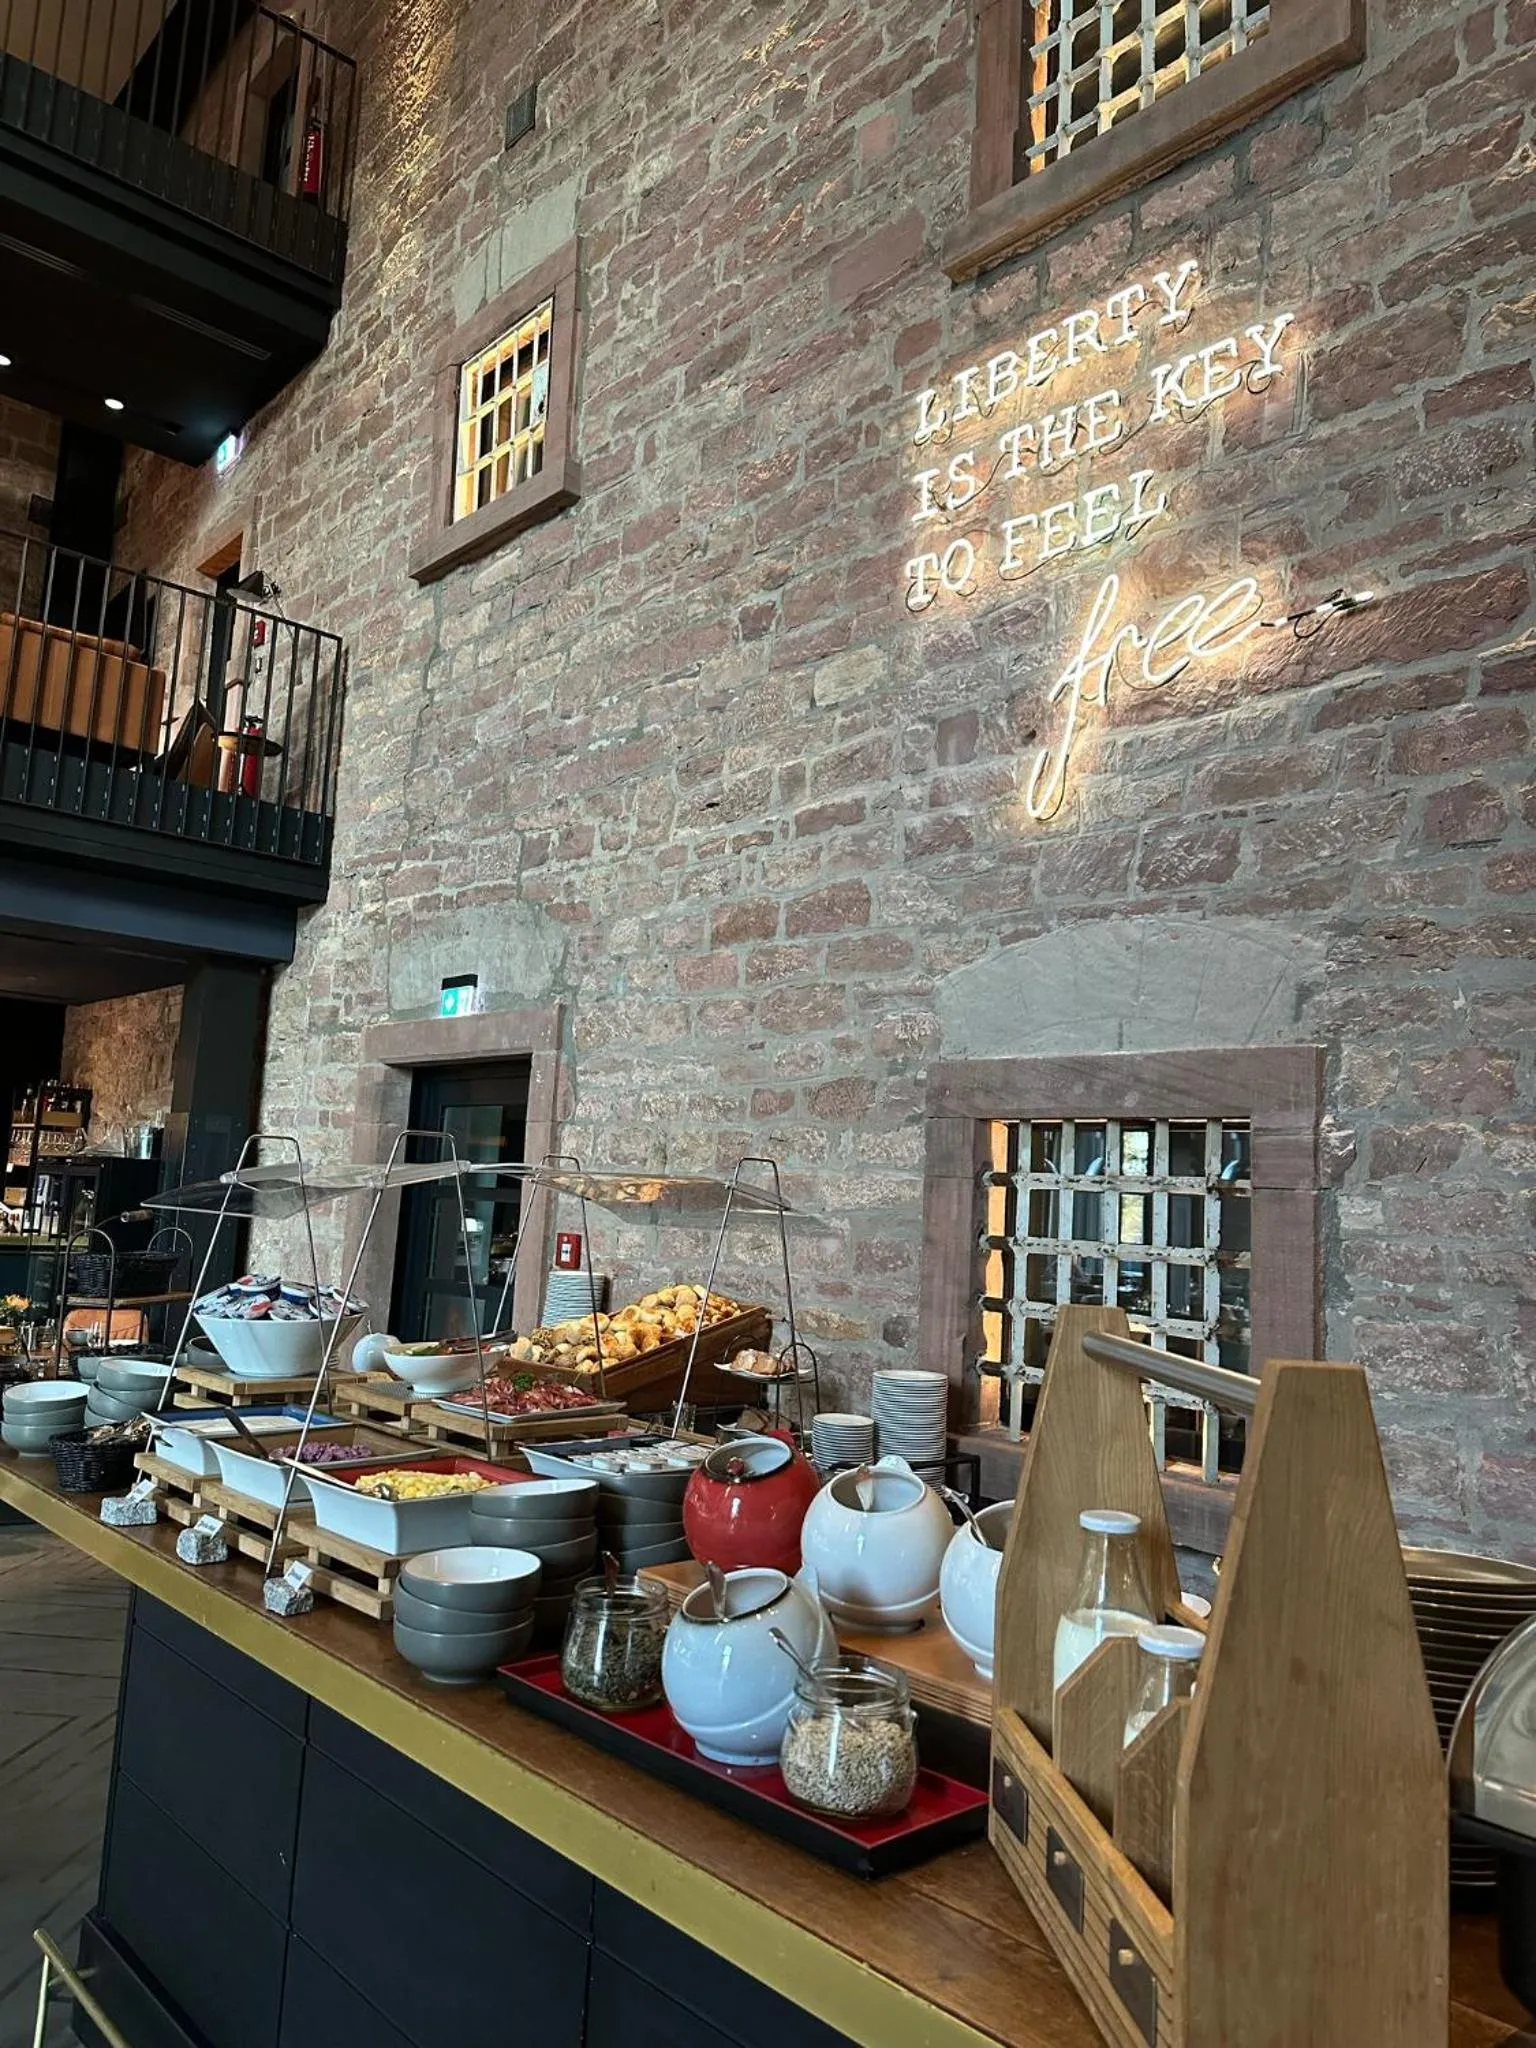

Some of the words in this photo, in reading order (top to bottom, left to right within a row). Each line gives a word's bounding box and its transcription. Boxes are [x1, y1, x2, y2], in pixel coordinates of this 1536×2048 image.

[911, 450, 976, 523] IS
[999, 390, 1124, 480] THE
[1150, 313, 1296, 423] KEY
[915, 260, 1199, 440] LIBERTY
[905, 538, 975, 606] TO
[1001, 469, 1168, 572] FEEL
[1027, 574, 1262, 818] free
